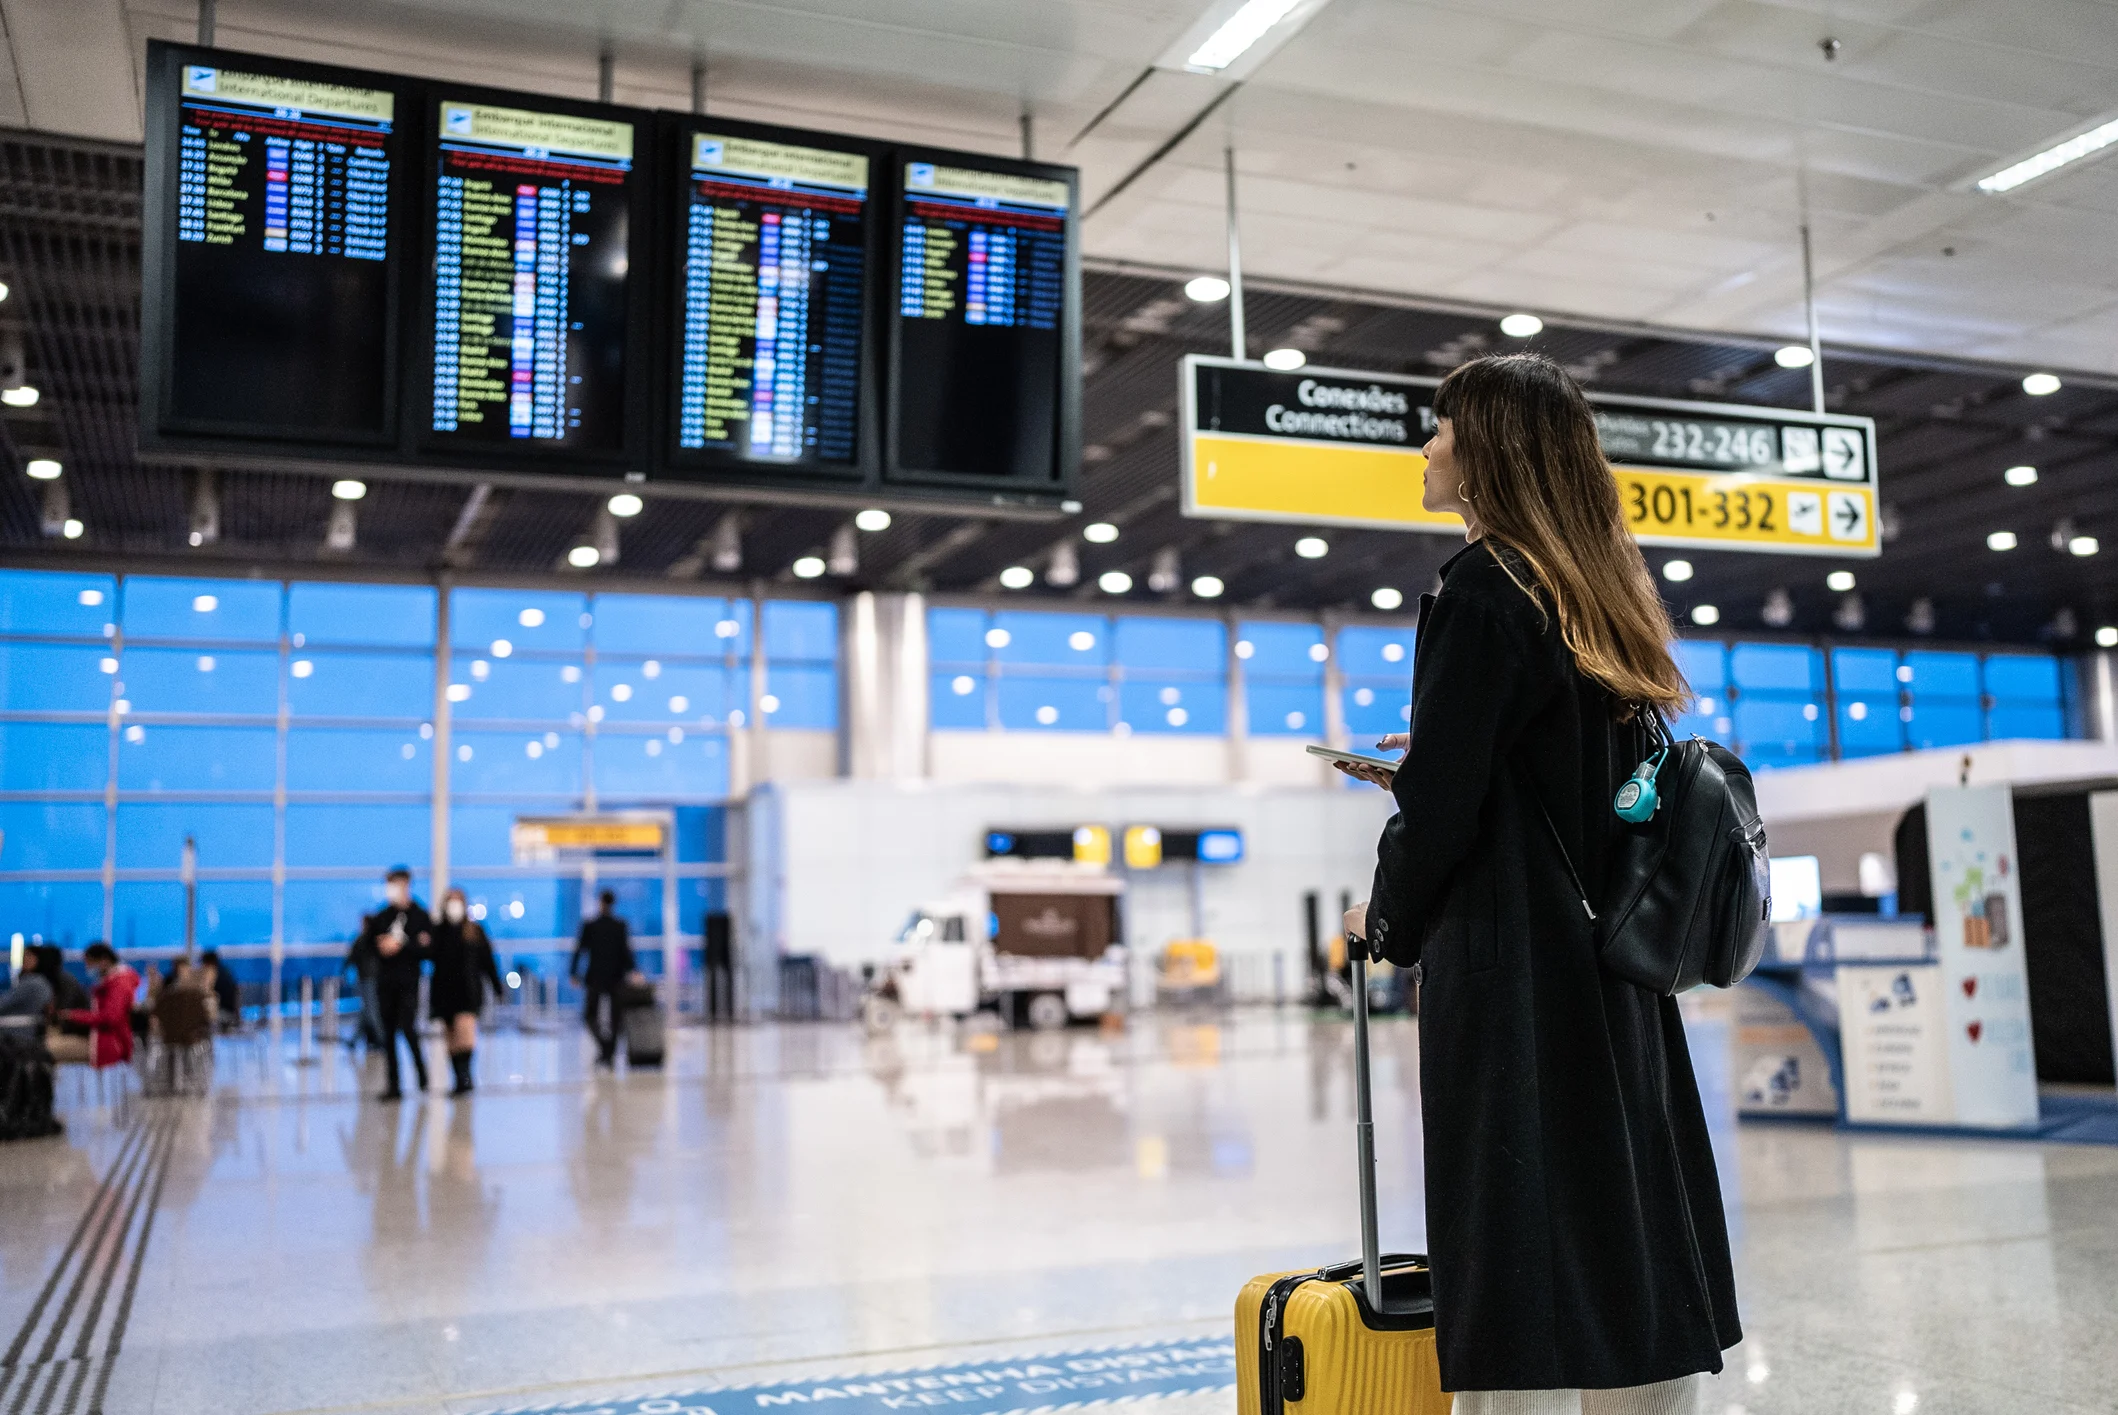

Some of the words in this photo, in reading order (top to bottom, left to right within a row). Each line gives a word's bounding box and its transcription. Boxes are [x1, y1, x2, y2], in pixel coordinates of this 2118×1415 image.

[219, 81, 304, 102] International
[308, 91, 379, 113] Departures
[1298, 379, 1409, 415] Conexões
[1265, 404, 1409, 441] Connections
[1651, 420, 1772, 465] 232-246
[1630, 481, 1777, 533] 301-332
[756, 1364, 1063, 1407] MANTENHA
[880, 1383, 1004, 1409] KEEP
